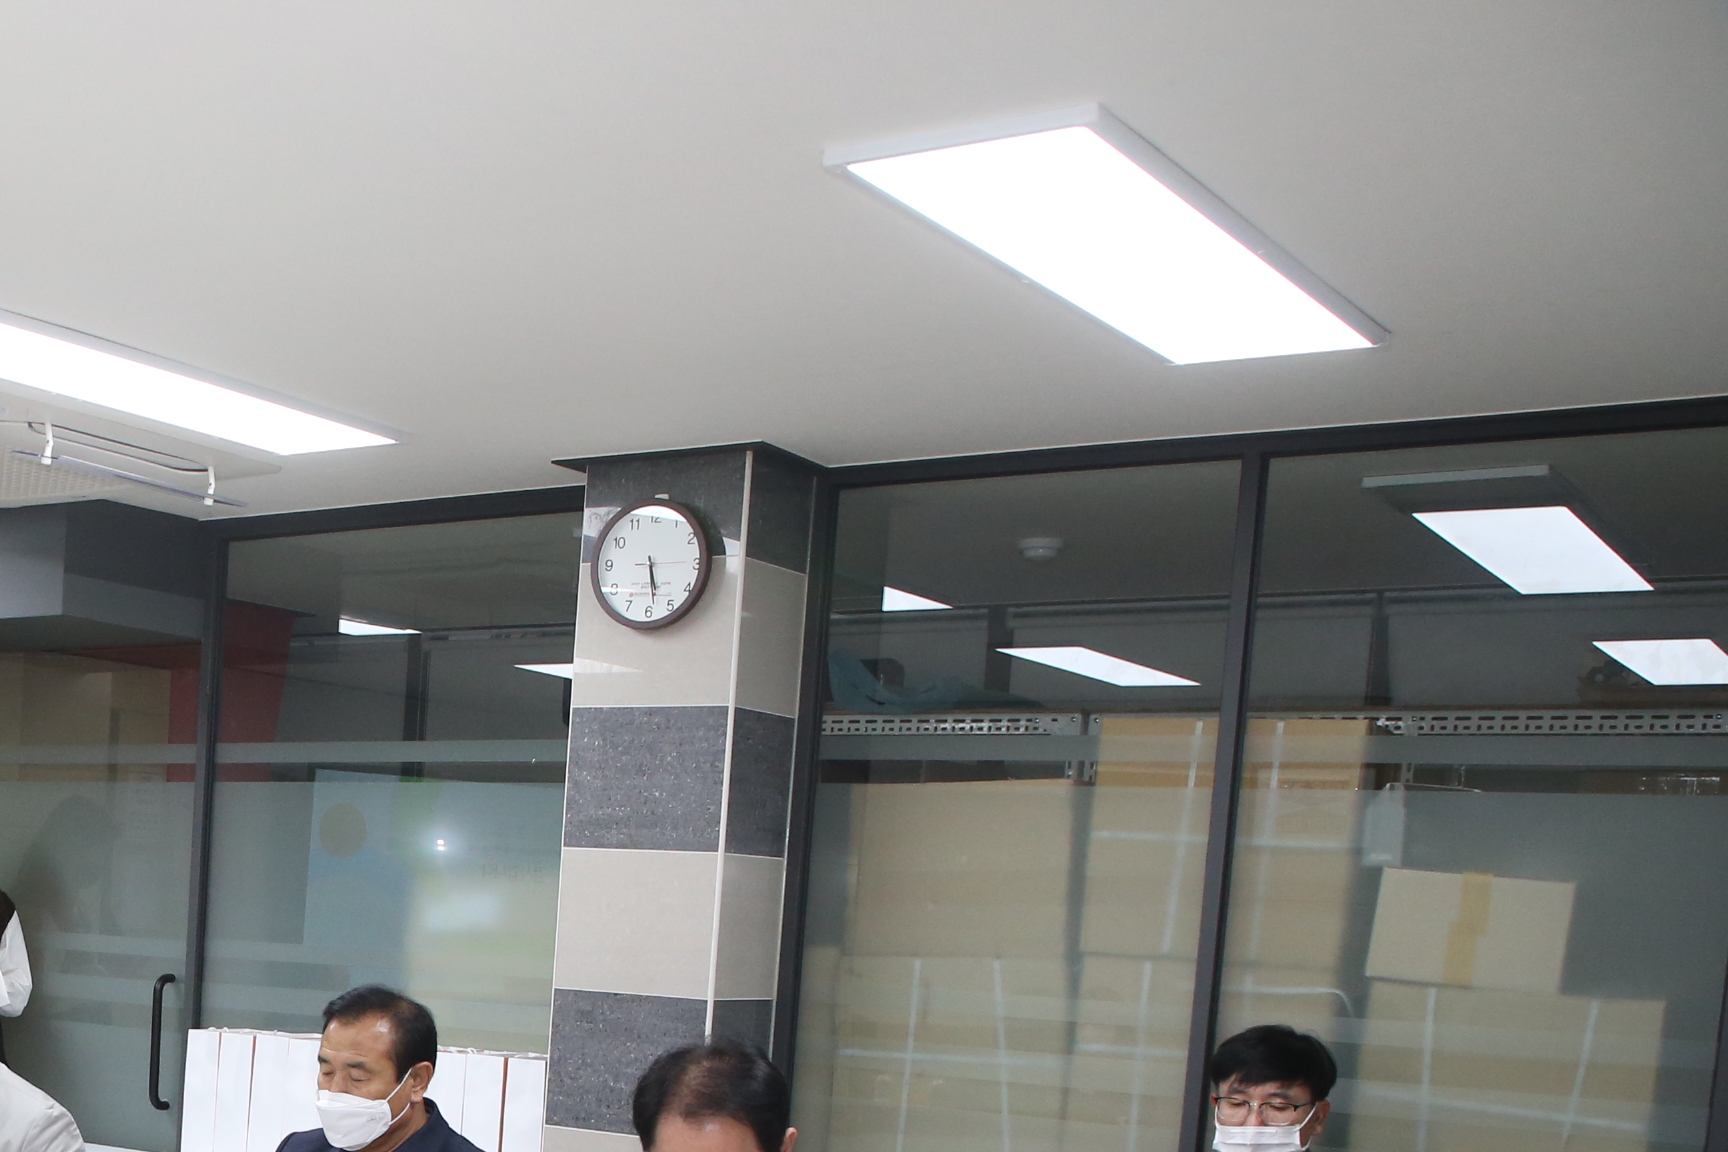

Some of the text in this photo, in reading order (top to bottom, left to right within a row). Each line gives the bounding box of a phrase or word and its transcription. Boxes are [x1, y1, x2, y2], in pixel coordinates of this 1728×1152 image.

[630, 518, 640, 530] 11
[613, 536, 626, 549] 10
[687, 532, 695, 545] 2
[605, 559, 613, 571] 9
[692, 557, 700, 570] 3
[610, 583, 618, 595] 8
[683, 582, 692, 592] 4
[625, 600, 633, 612] 7
[666, 599, 675, 612] 5
[644, 606, 653, 618] 6
